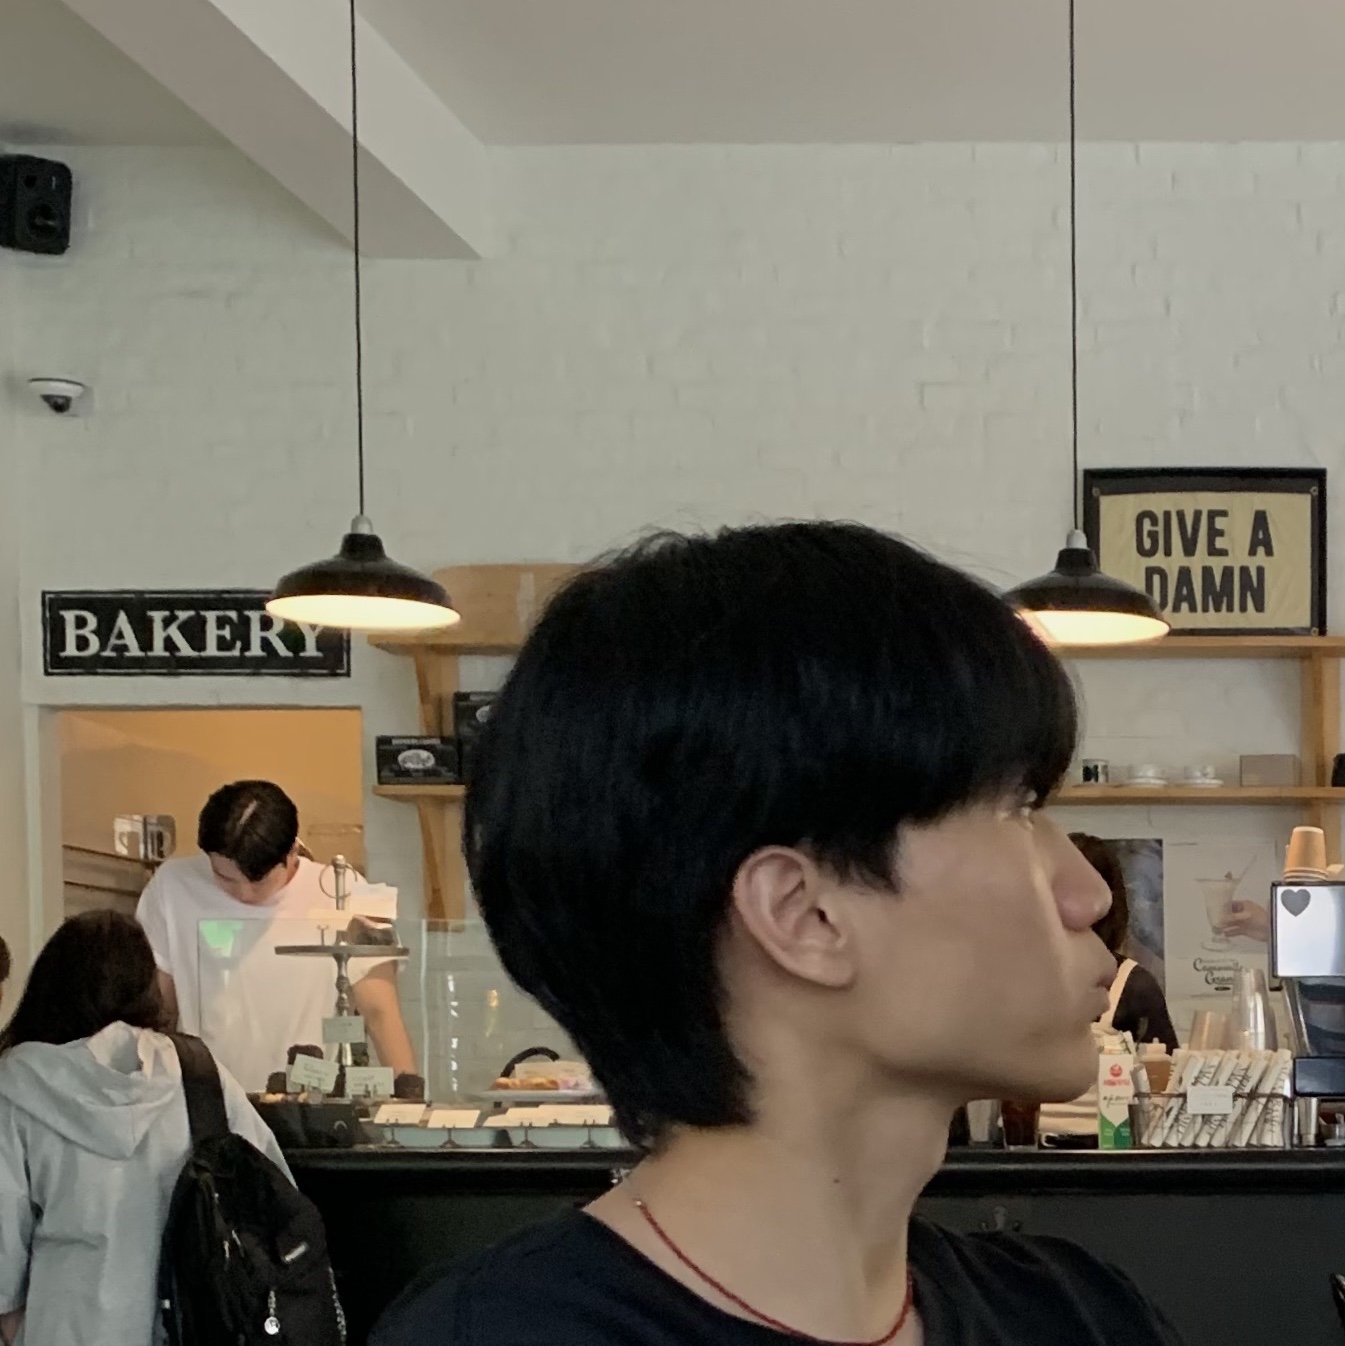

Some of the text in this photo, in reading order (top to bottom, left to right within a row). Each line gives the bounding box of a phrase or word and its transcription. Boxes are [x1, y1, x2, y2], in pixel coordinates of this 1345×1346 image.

[1136, 509, 1274, 557] GIVE A
[1145, 565, 1265, 613] DAMN
[59, 609, 325, 657] BAKERY
